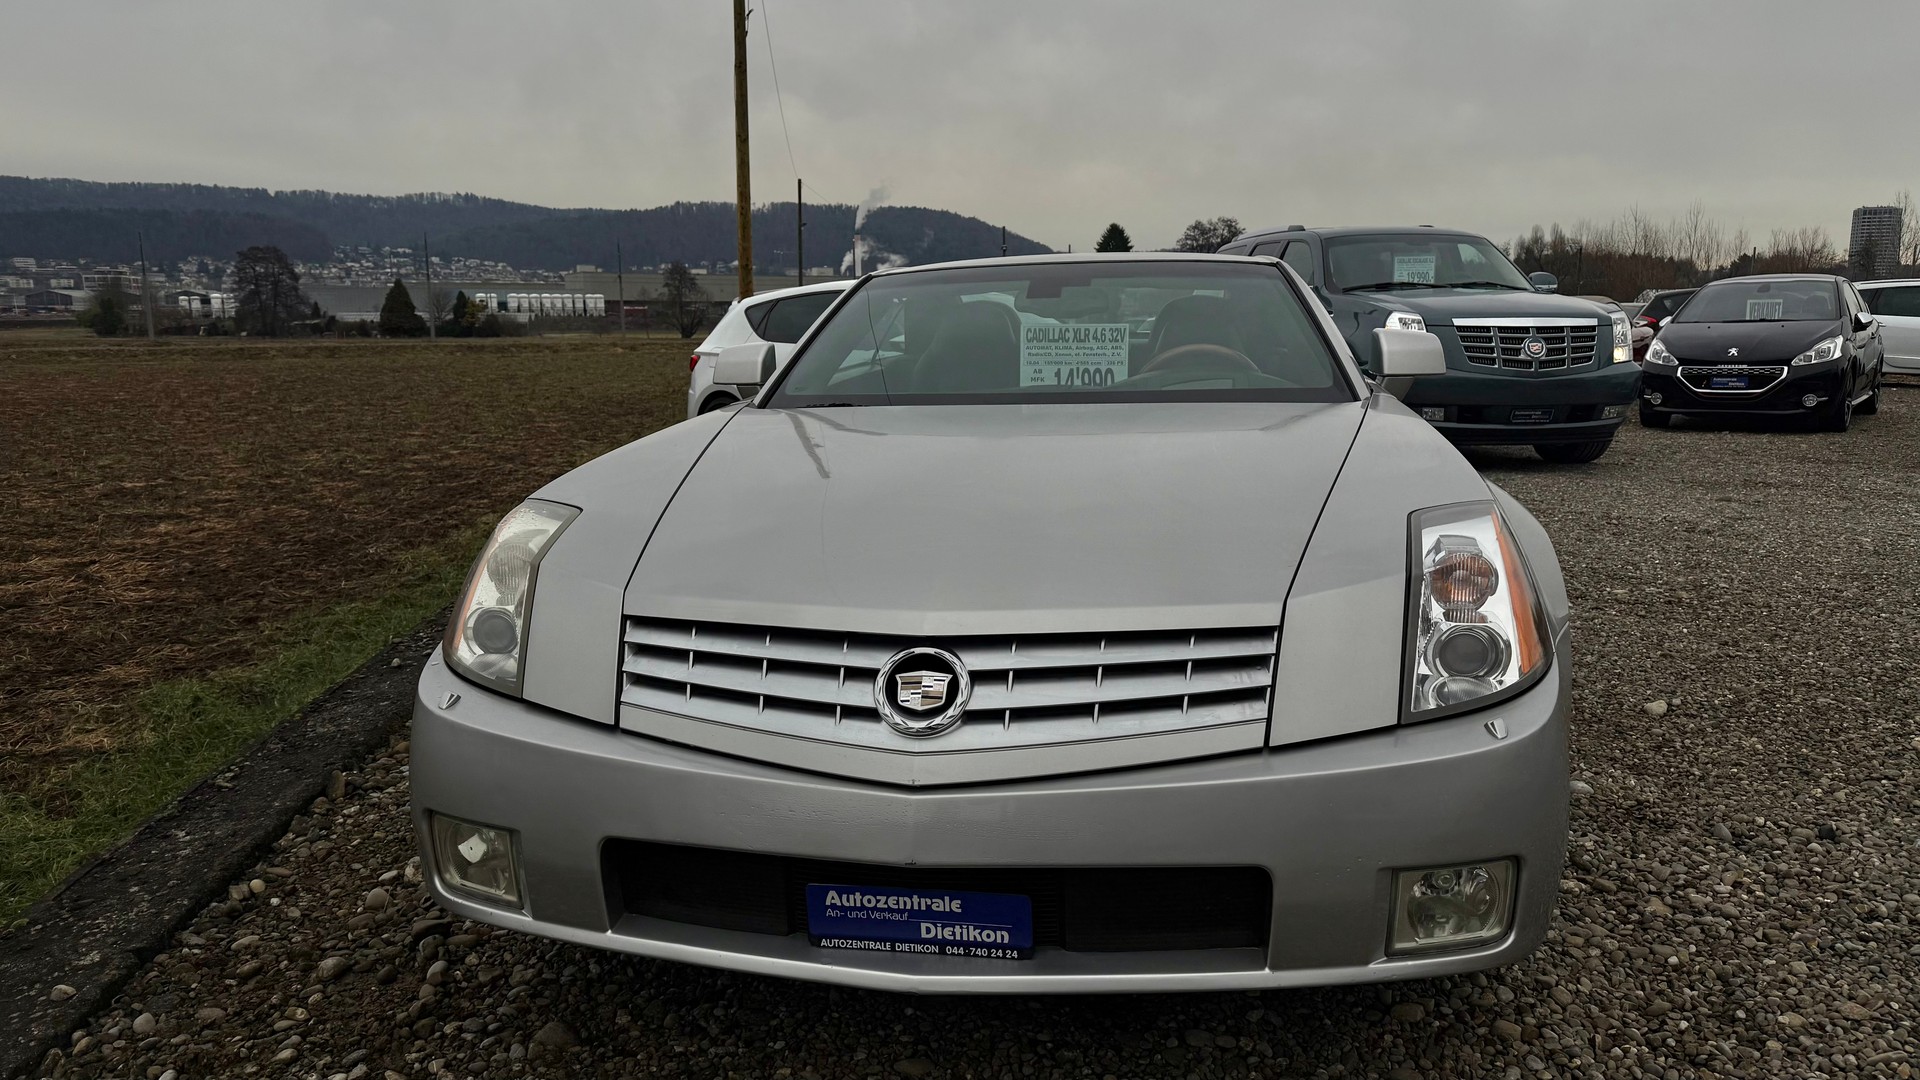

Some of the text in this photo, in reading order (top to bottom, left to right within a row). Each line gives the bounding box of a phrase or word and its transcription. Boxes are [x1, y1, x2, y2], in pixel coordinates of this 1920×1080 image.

[1026, 328, 1126, 343] CADILLAC XLR 4.6 32V
[825, 890, 962, 912] Autozentrale
[848, 910, 867, 918] und
[869, 910, 909, 921] Verkauf
[920, 922, 1010, 944] Dietikon
[820, 938, 892, 951] AUTOZENTRALE
[895, 942, 939, 954] DIETIKON
[990, 949, 1003, 958] 24
[1005, 950, 1018, 959] 24
